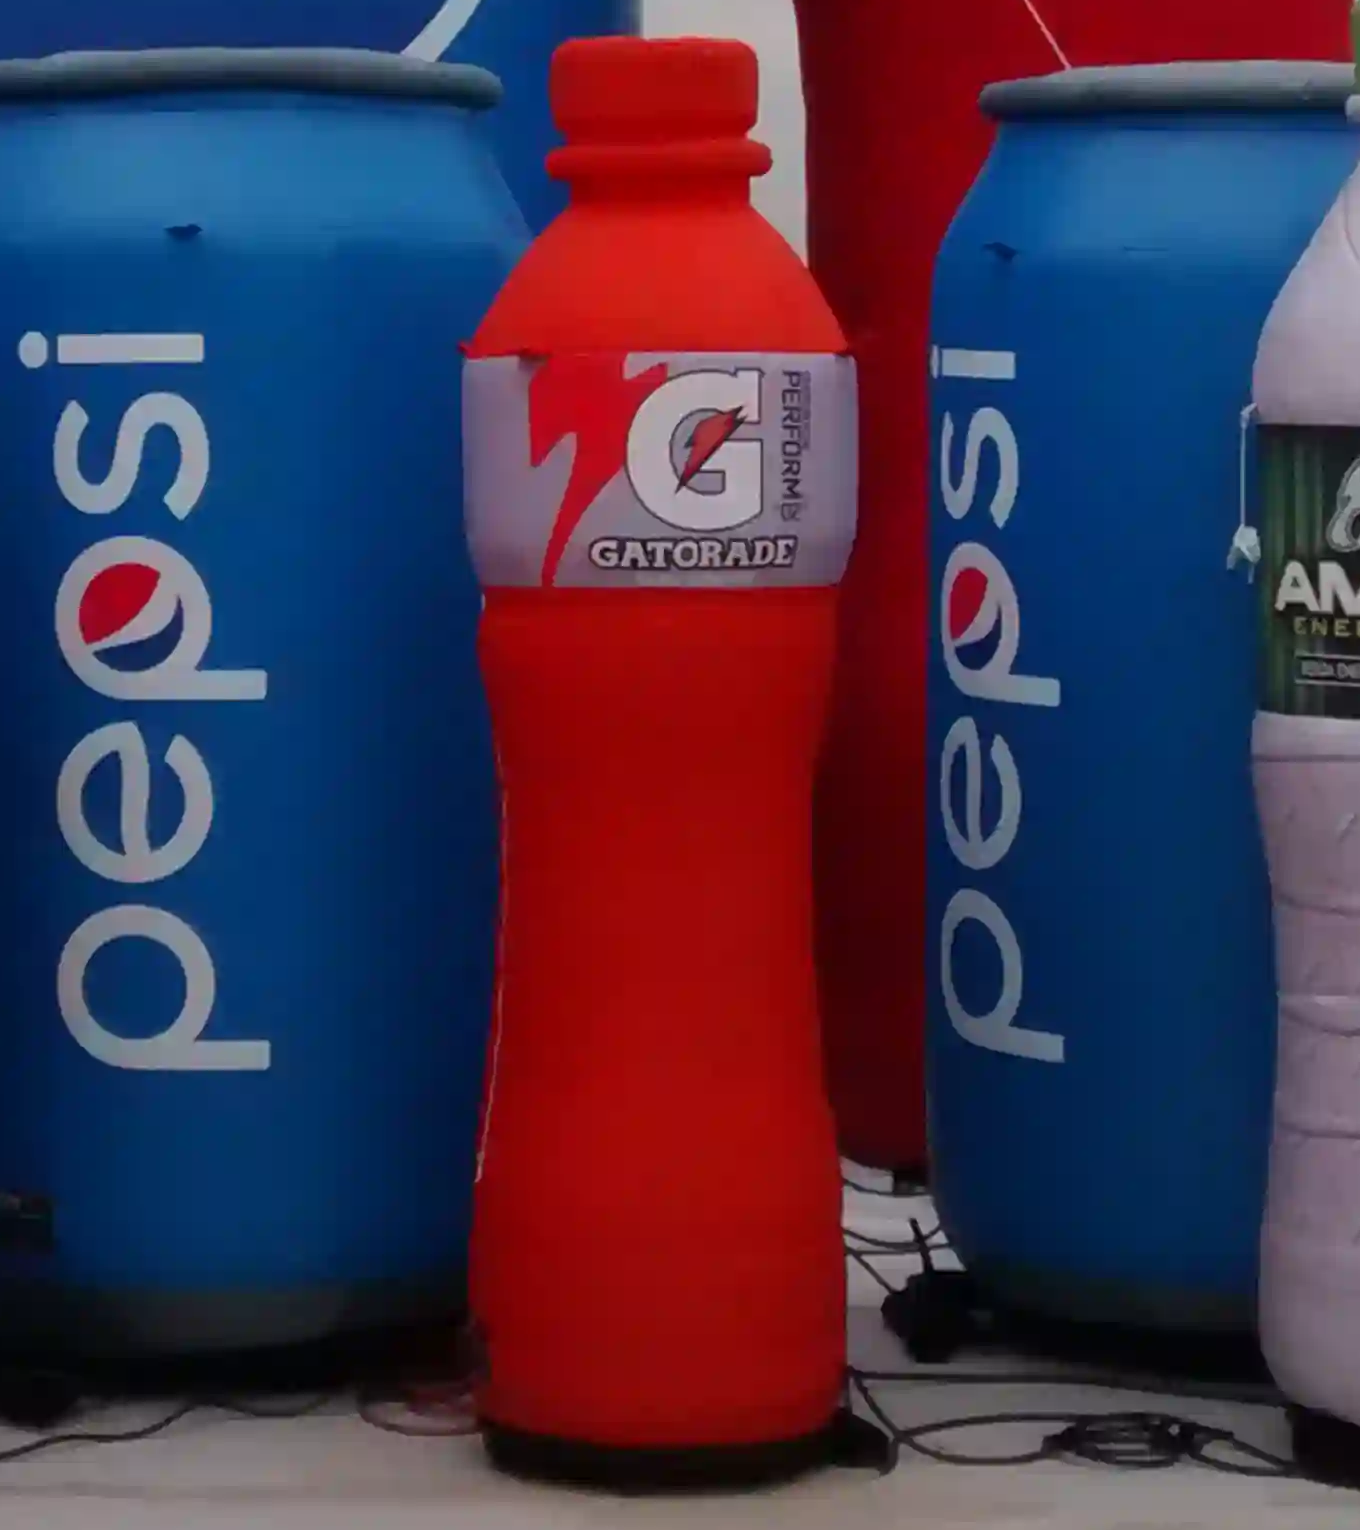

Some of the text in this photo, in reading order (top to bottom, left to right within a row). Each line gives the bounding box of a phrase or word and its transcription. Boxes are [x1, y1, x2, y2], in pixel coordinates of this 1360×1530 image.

[625, 366, 765, 533] G
[780, 370, 802, 499] PERFORM
[588, 534, 799, 572] GATORADE
[17, 330, 271, 1071] pepsi
[929, 344, 1066, 1063] pepsi
